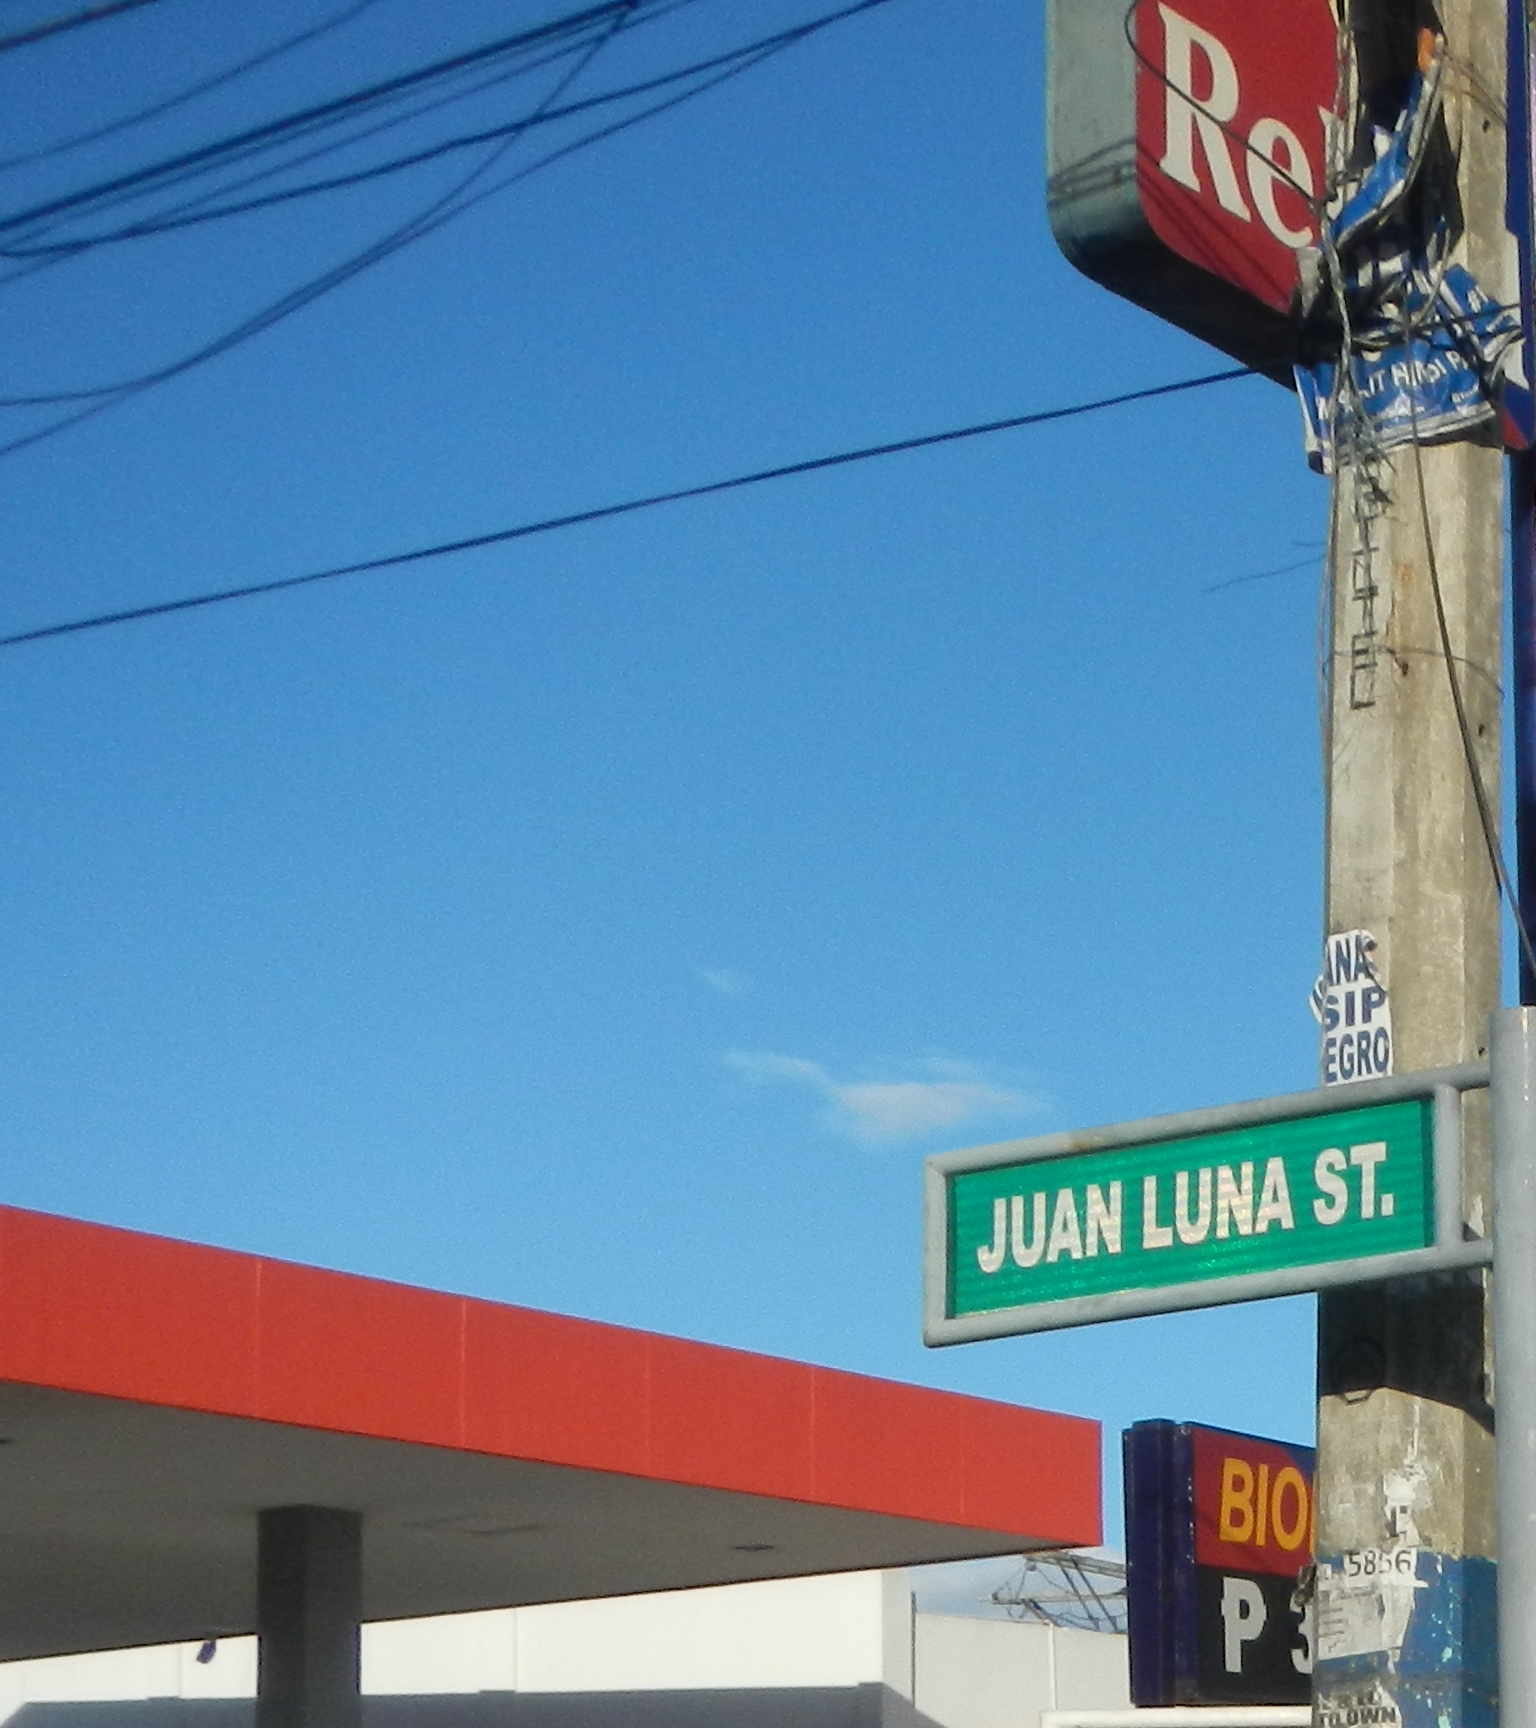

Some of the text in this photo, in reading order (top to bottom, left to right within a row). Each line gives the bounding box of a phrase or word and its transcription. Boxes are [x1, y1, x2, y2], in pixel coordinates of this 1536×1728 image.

[1158, 2, 1345, 249] Re
[1324, 986, 1386, 1033] SIP
[977, 1141, 1395, 1274] JUAN LUNA ST.
[1219, 1457, 1315, 1558] BIO
[1221, 1576, 1267, 1674] P
